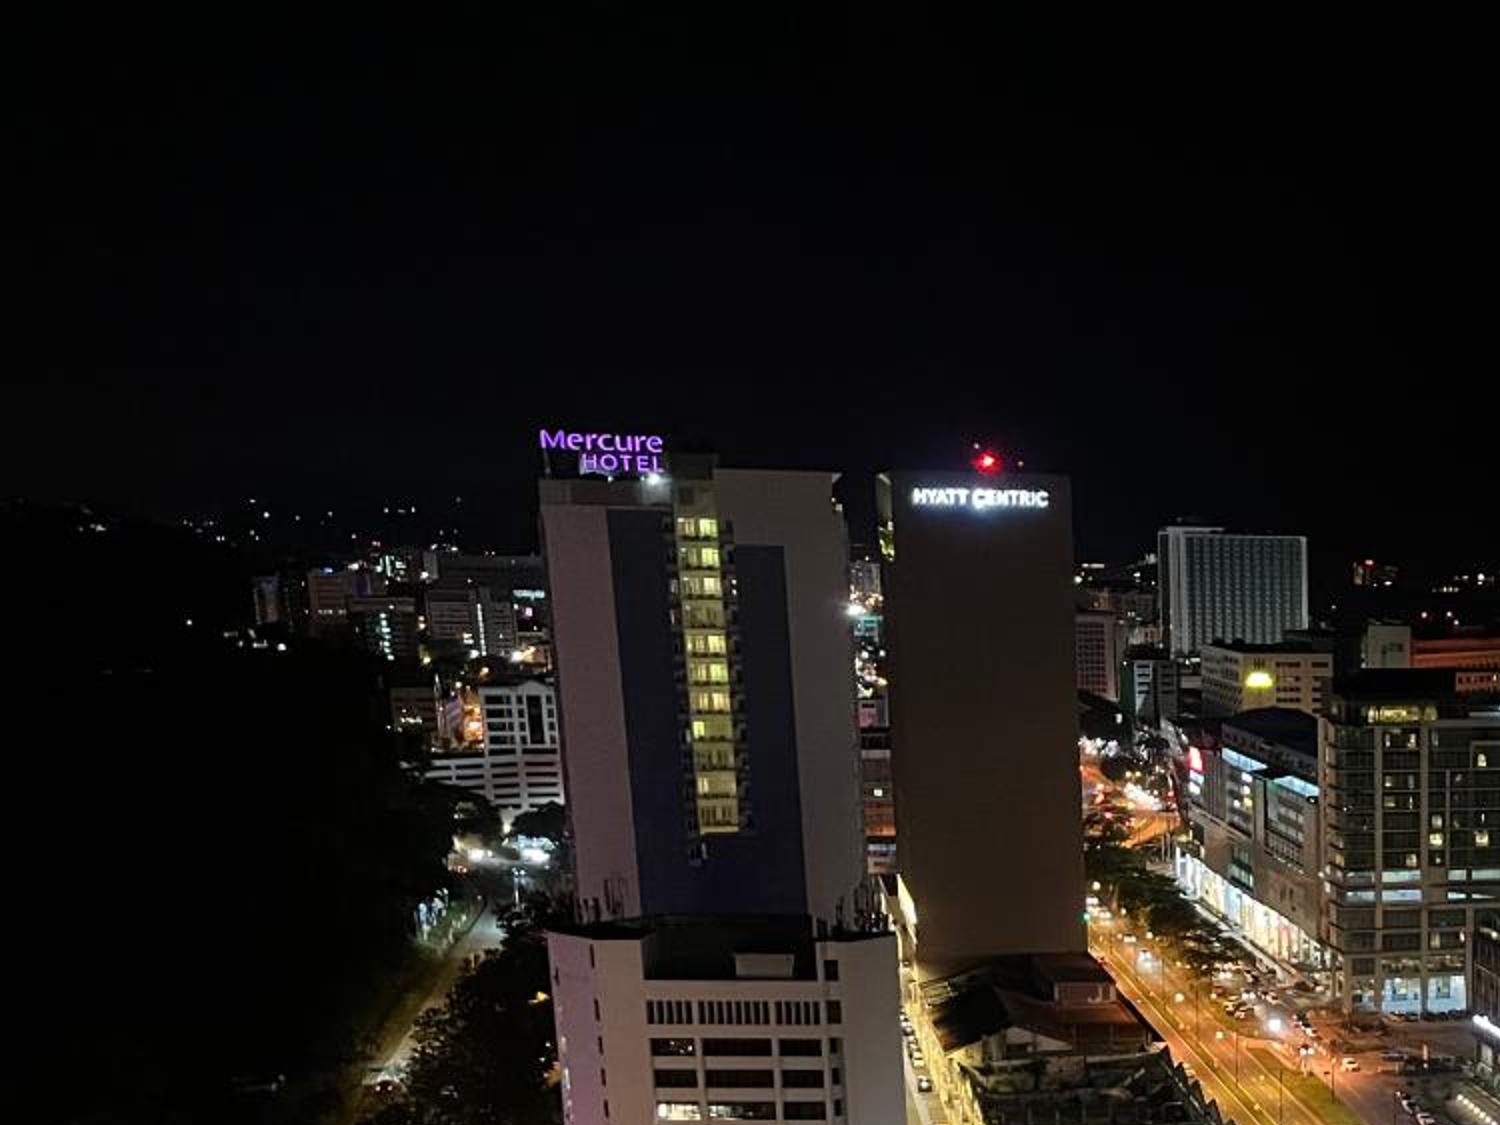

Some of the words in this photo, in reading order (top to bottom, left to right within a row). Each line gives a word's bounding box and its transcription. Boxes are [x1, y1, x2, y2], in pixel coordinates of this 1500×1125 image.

[539, 429, 664, 453] Mercure
[582, 453, 665, 473] HOTEL
[912, 487, 970, 506] HYATT
[972, 488, 1050, 508] CENTRIC
